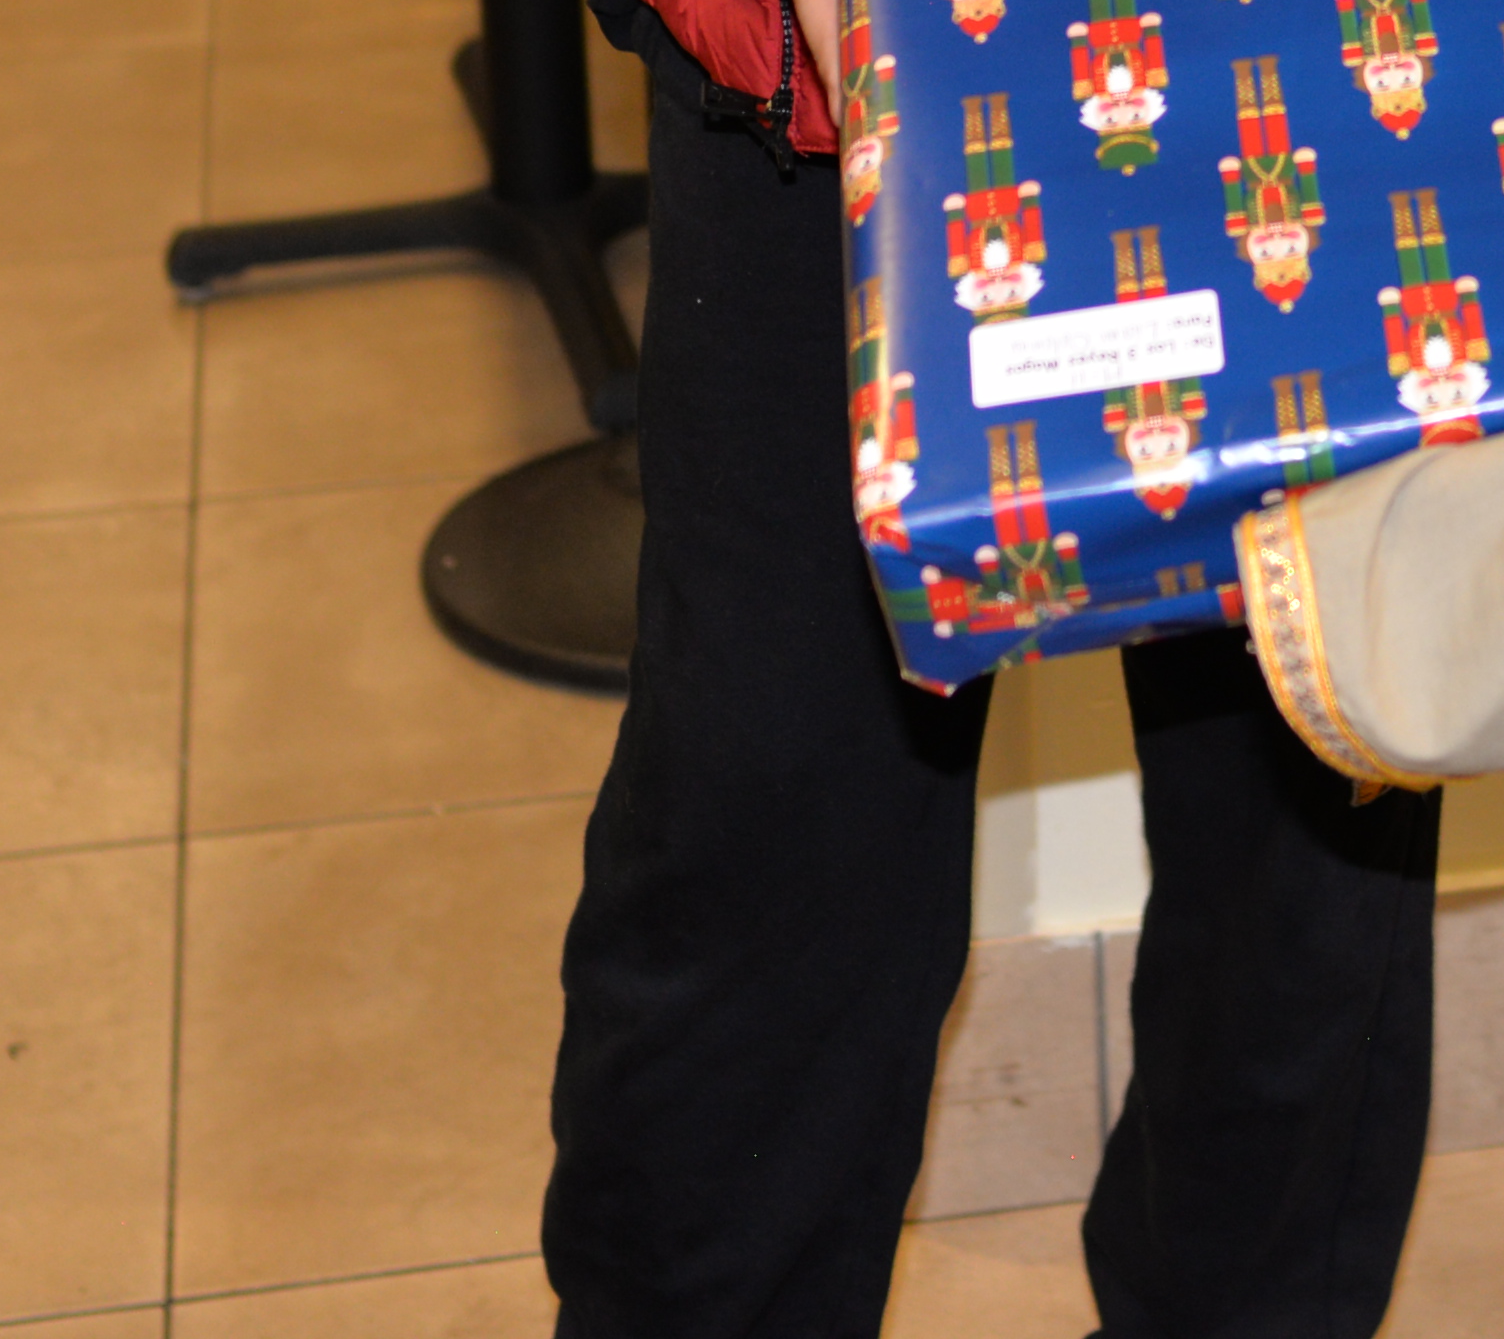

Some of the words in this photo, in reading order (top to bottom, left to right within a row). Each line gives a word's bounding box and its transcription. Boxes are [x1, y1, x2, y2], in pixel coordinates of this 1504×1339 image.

[1146, 339, 1178, 356] Los
[1004, 356, 1061, 377] Magos
[1067, 348, 1121, 367] Reyes
